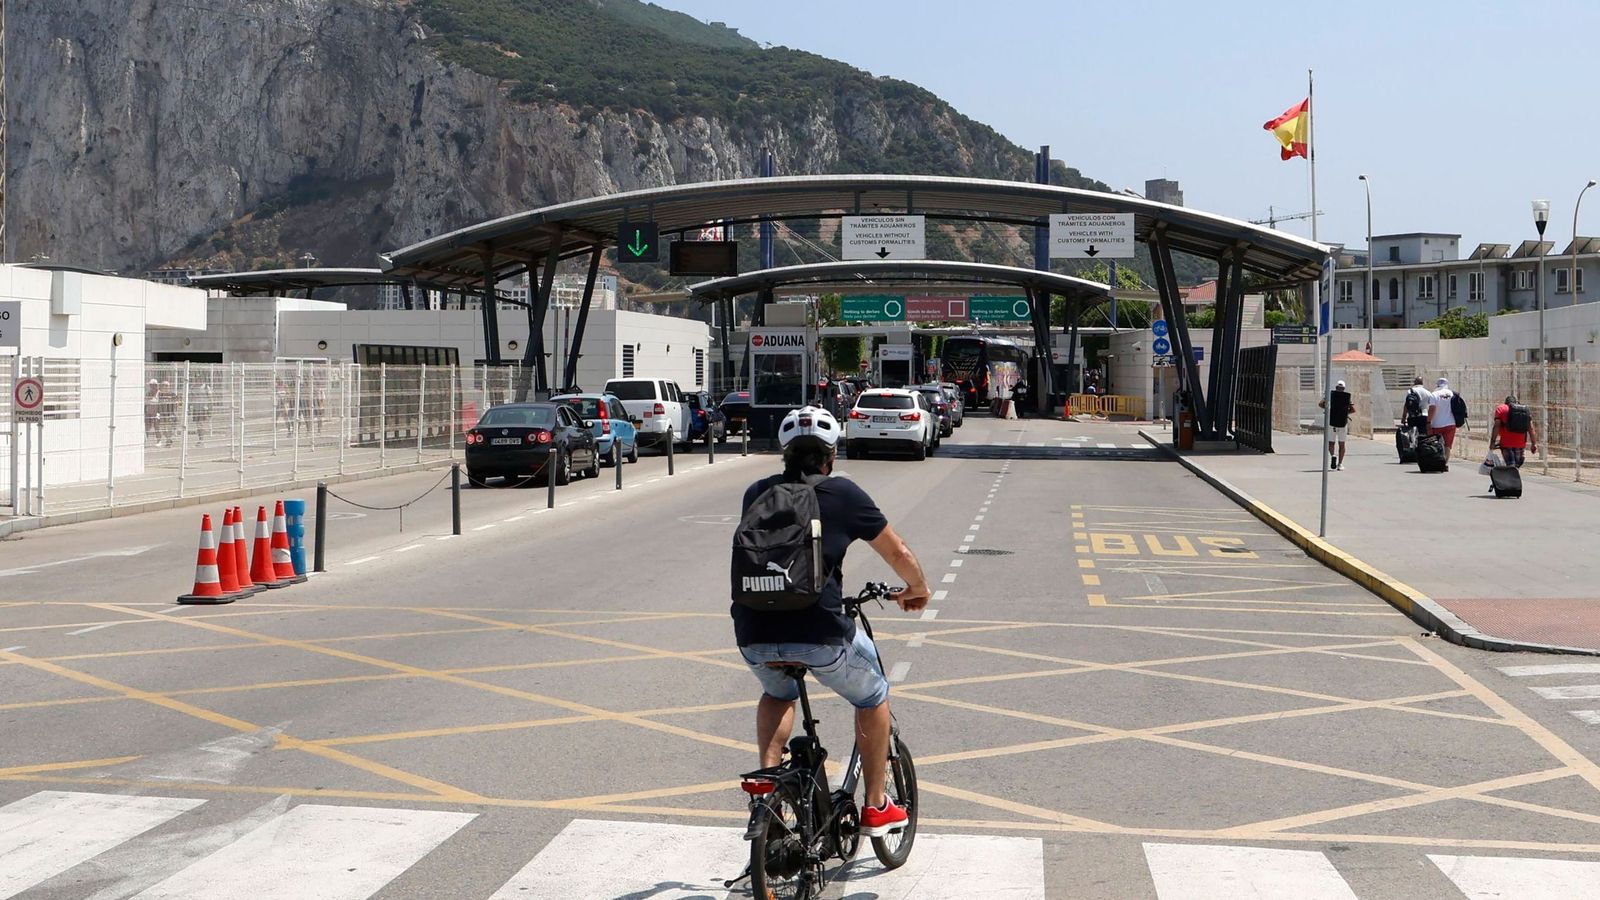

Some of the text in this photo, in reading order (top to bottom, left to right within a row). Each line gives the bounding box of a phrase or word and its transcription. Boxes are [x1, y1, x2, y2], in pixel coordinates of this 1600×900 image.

[763, 335, 805, 346] ADUANA
[1089, 532, 1260, 559] BUS
[742, 575, 785, 592] PUMA
